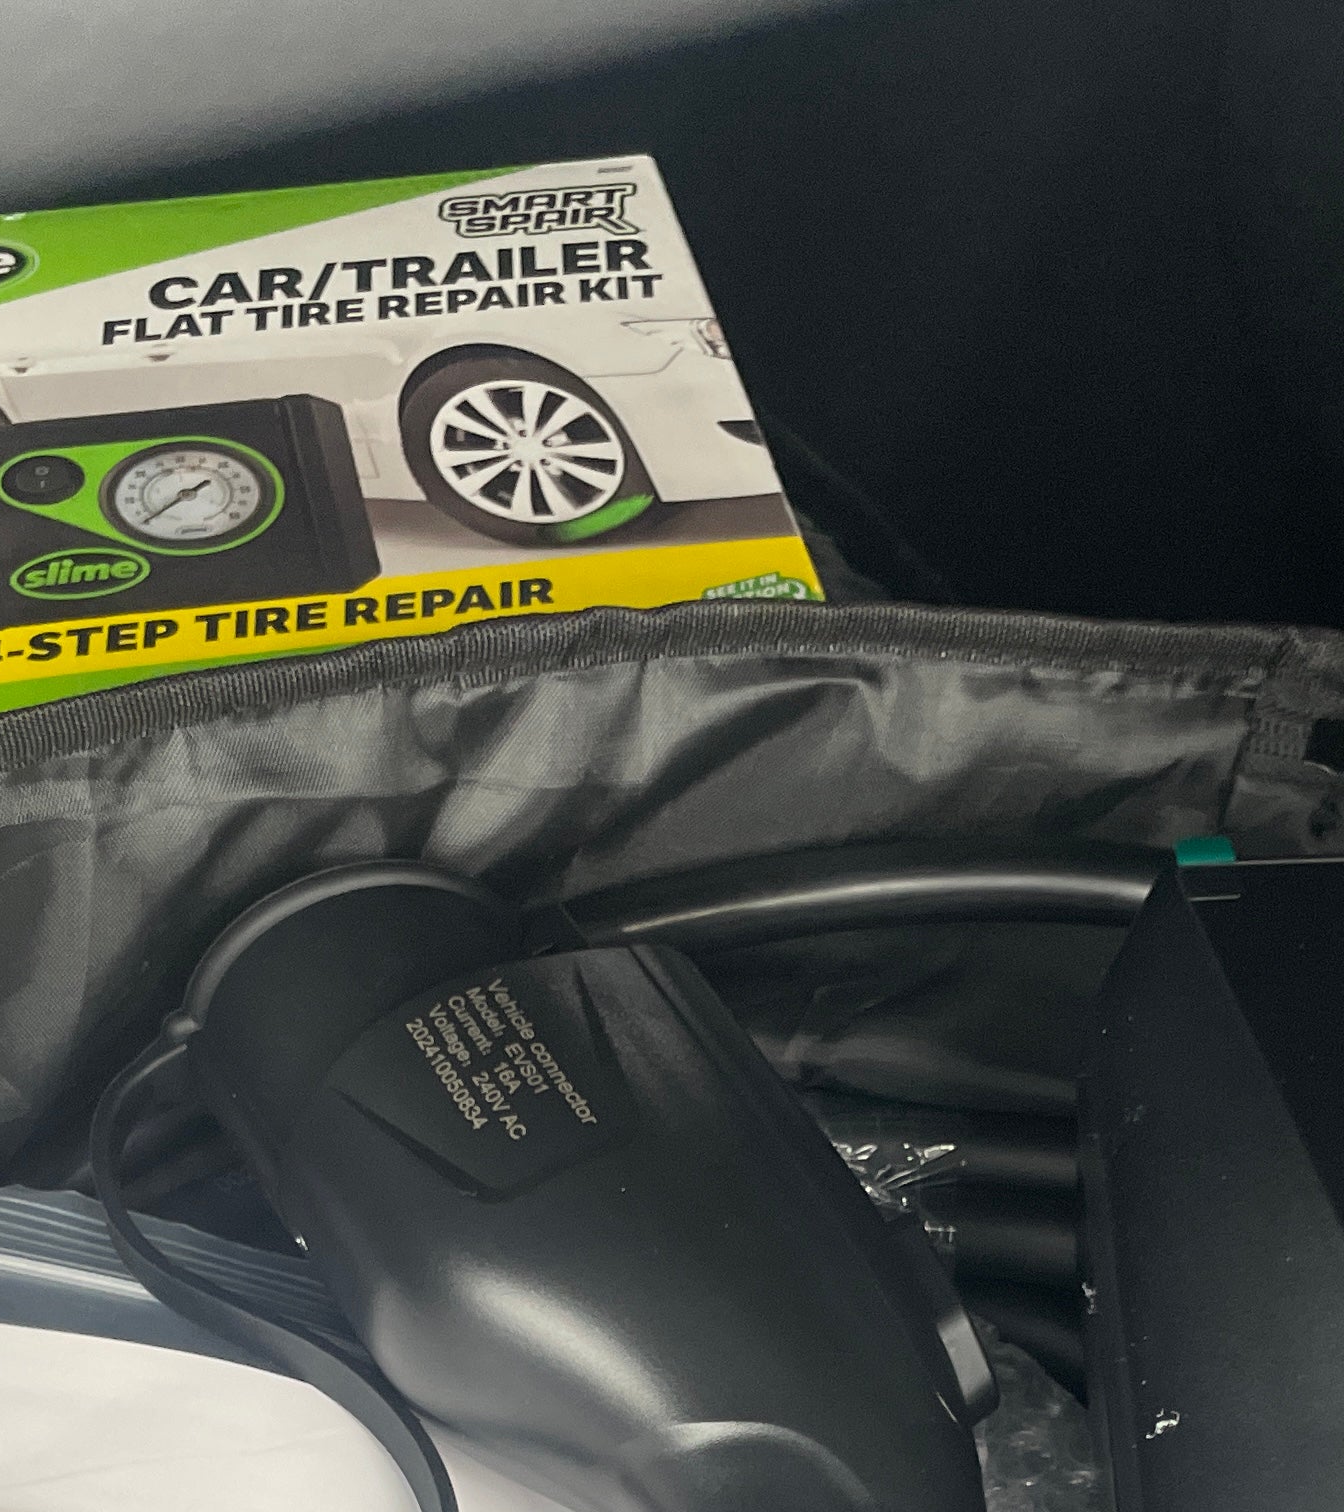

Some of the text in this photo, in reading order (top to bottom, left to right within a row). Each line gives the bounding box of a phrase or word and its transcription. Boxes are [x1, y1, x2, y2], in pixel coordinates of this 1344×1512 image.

[444, 186, 631, 219] SMART
[463, 206, 632, 233] SPAIR
[148, 238, 652, 311] CAR/TRAILER
[101, 273, 664, 347] FLAT TIRE REPAIR KIT
[22, 558, 140, 590] slime
[706, 572, 778, 600] SEE IT IN
[732, 581, 791, 600] ION
[195, 601, 329, 643] TIRE
[343, 577, 555, 627] REPAIR
[488, 977, 598, 1126] Vehicle connector
[505, 1042, 550, 1095] EVS01
[493, 1061, 522, 1095] 16A
[471, 1071, 511, 1112] 240V
[498, 1113, 528, 1140] AC
